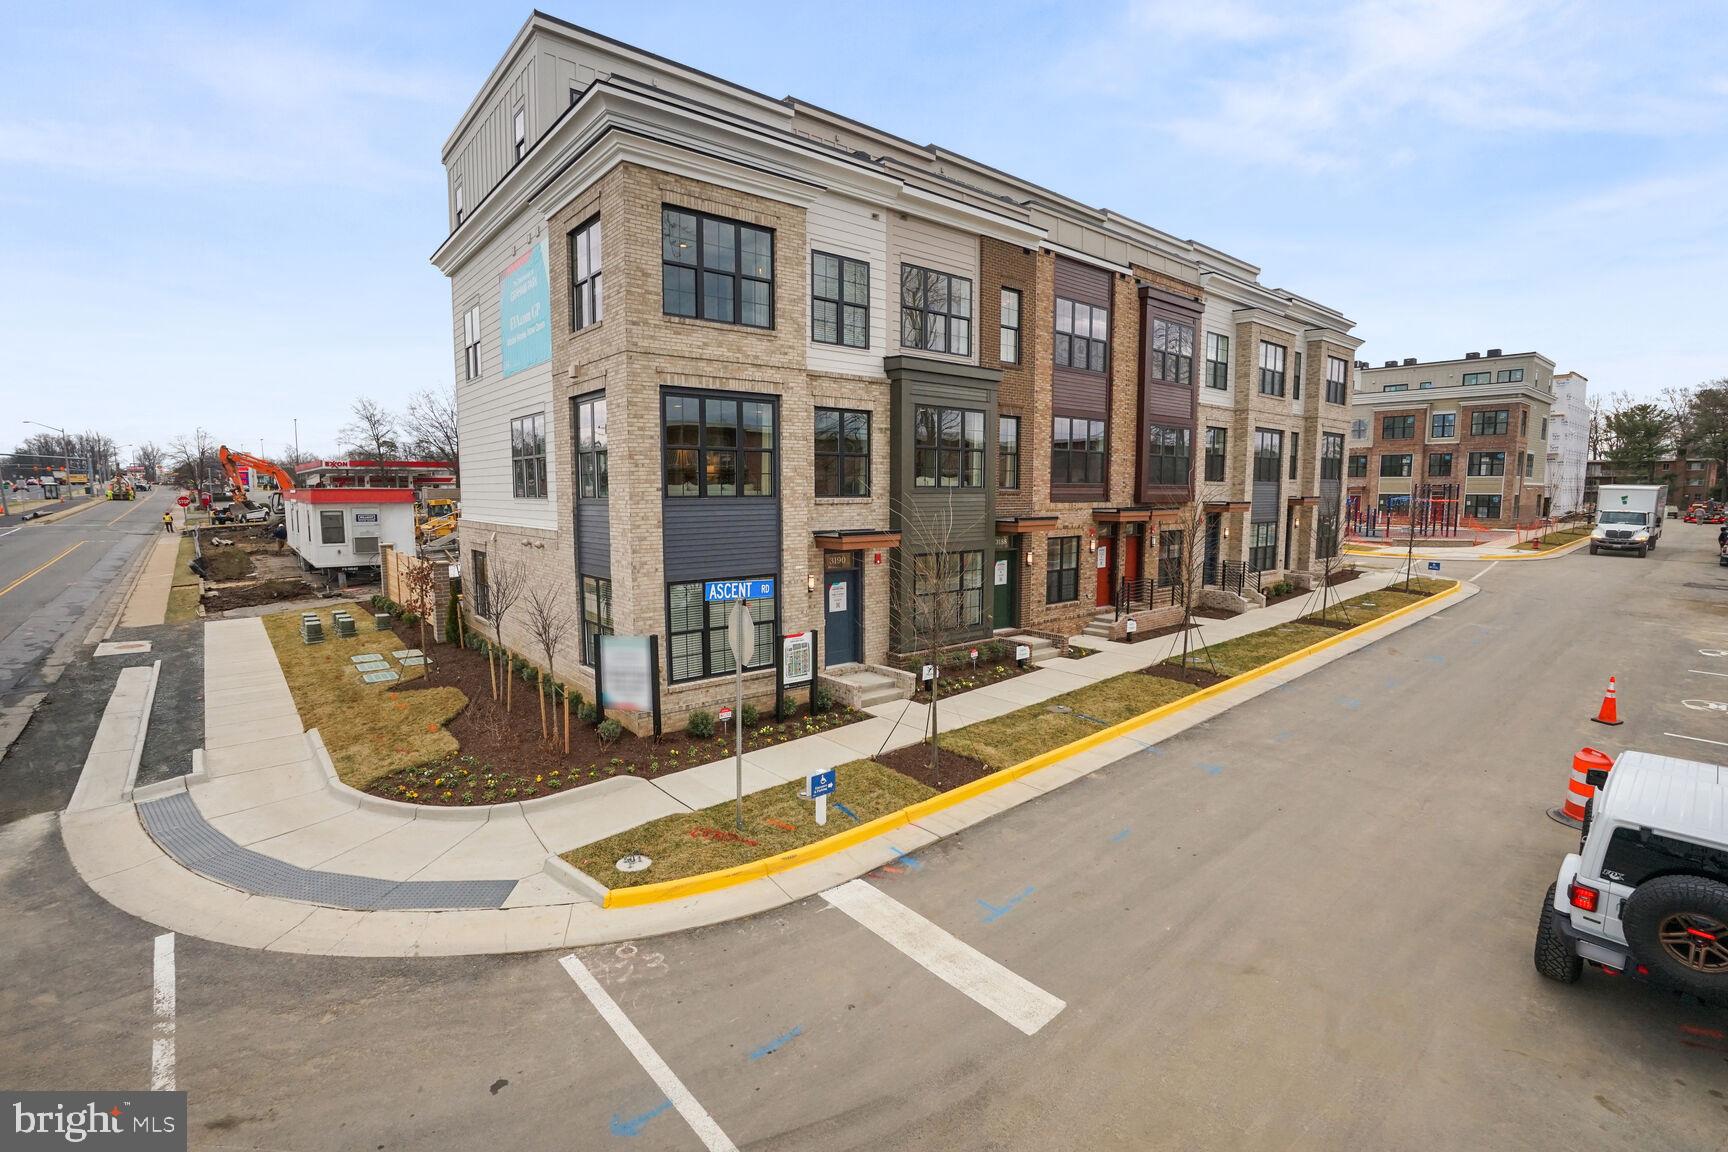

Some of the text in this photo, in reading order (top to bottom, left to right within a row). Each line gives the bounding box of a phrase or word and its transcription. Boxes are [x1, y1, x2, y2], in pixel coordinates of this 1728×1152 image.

[325, 460, 348, 469] EXXON
[829, 556, 846, 565] 3190
[709, 582, 770, 600] ASCENT RD
